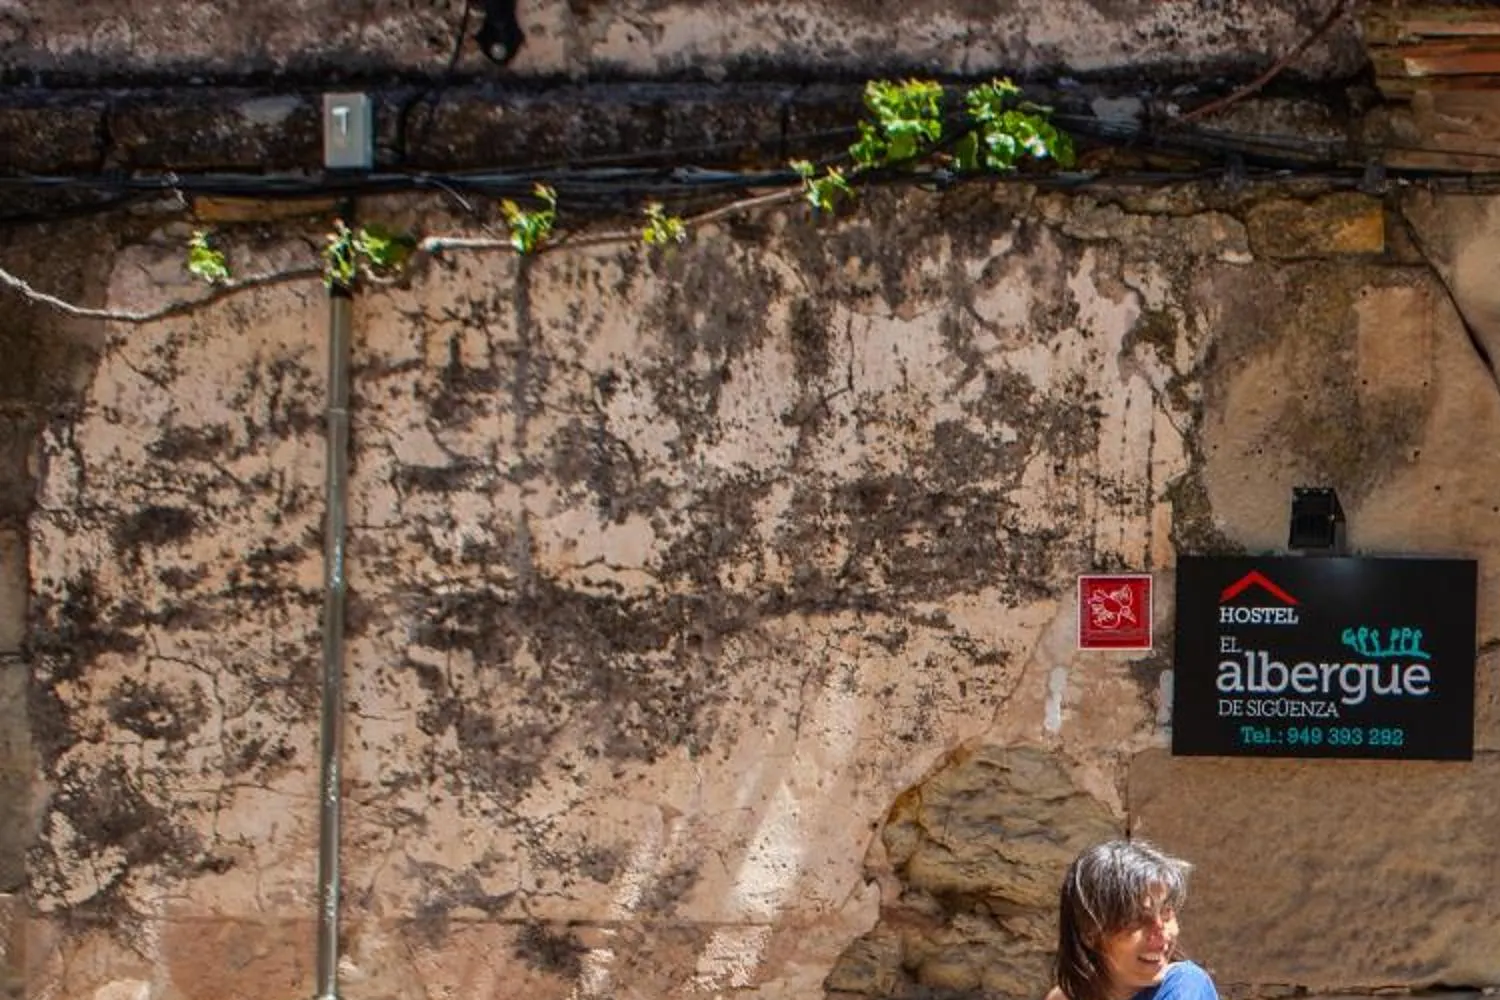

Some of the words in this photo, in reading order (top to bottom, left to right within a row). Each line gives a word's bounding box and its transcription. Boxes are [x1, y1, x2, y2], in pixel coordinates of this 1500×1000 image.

[1219, 607, 1299, 625] HOSTEL
[1220, 636, 1242, 653] EL
[1215, 651, 1431, 705] albergue
[1218, 700, 1243, 716] DE
[1246, 698, 1340, 718] SIGÜENZA
[1287, 727, 1323, 745] 949
[1327, 728, 1363, 746] 393
[1367, 729, 1404, 746] 292
